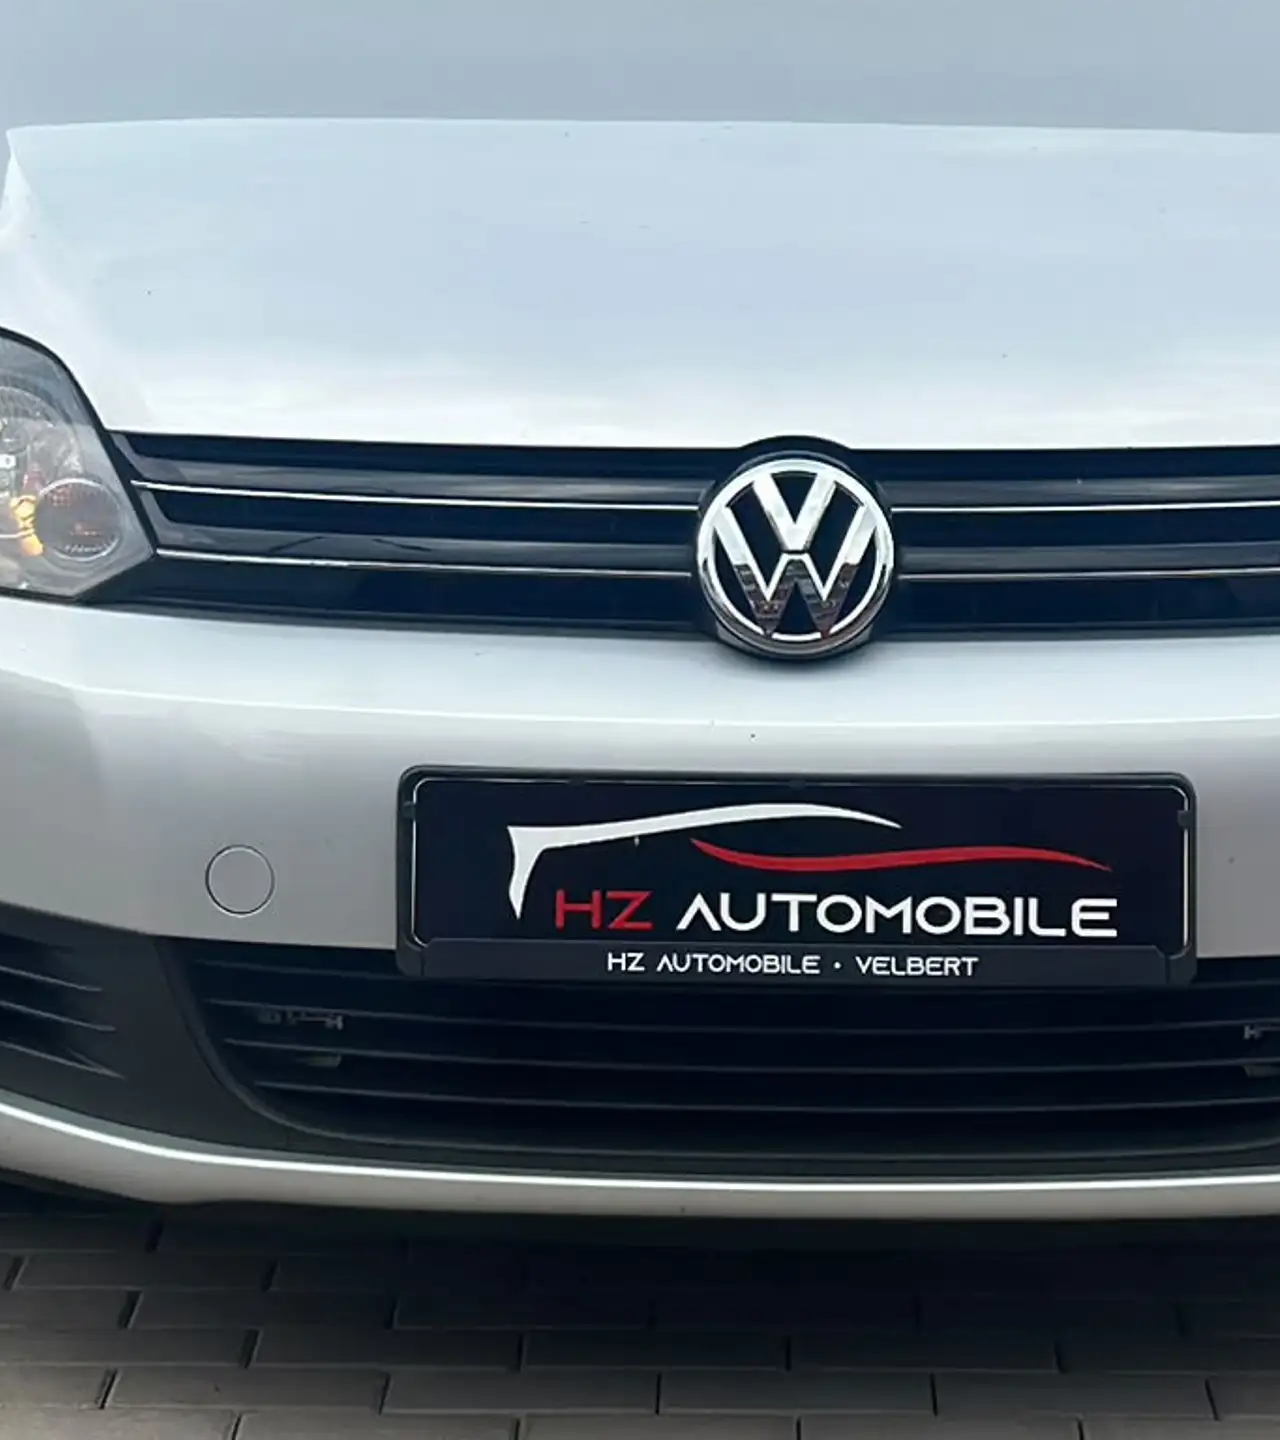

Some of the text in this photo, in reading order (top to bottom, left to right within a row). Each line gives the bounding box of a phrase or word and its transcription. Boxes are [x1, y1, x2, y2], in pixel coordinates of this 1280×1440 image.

[704, 460, 886, 644] VW
[554, 889, 1118, 938] HZ AUTOMOBILE
[607, 952, 979, 977] HZ AUTOMOBILE VELBERT
